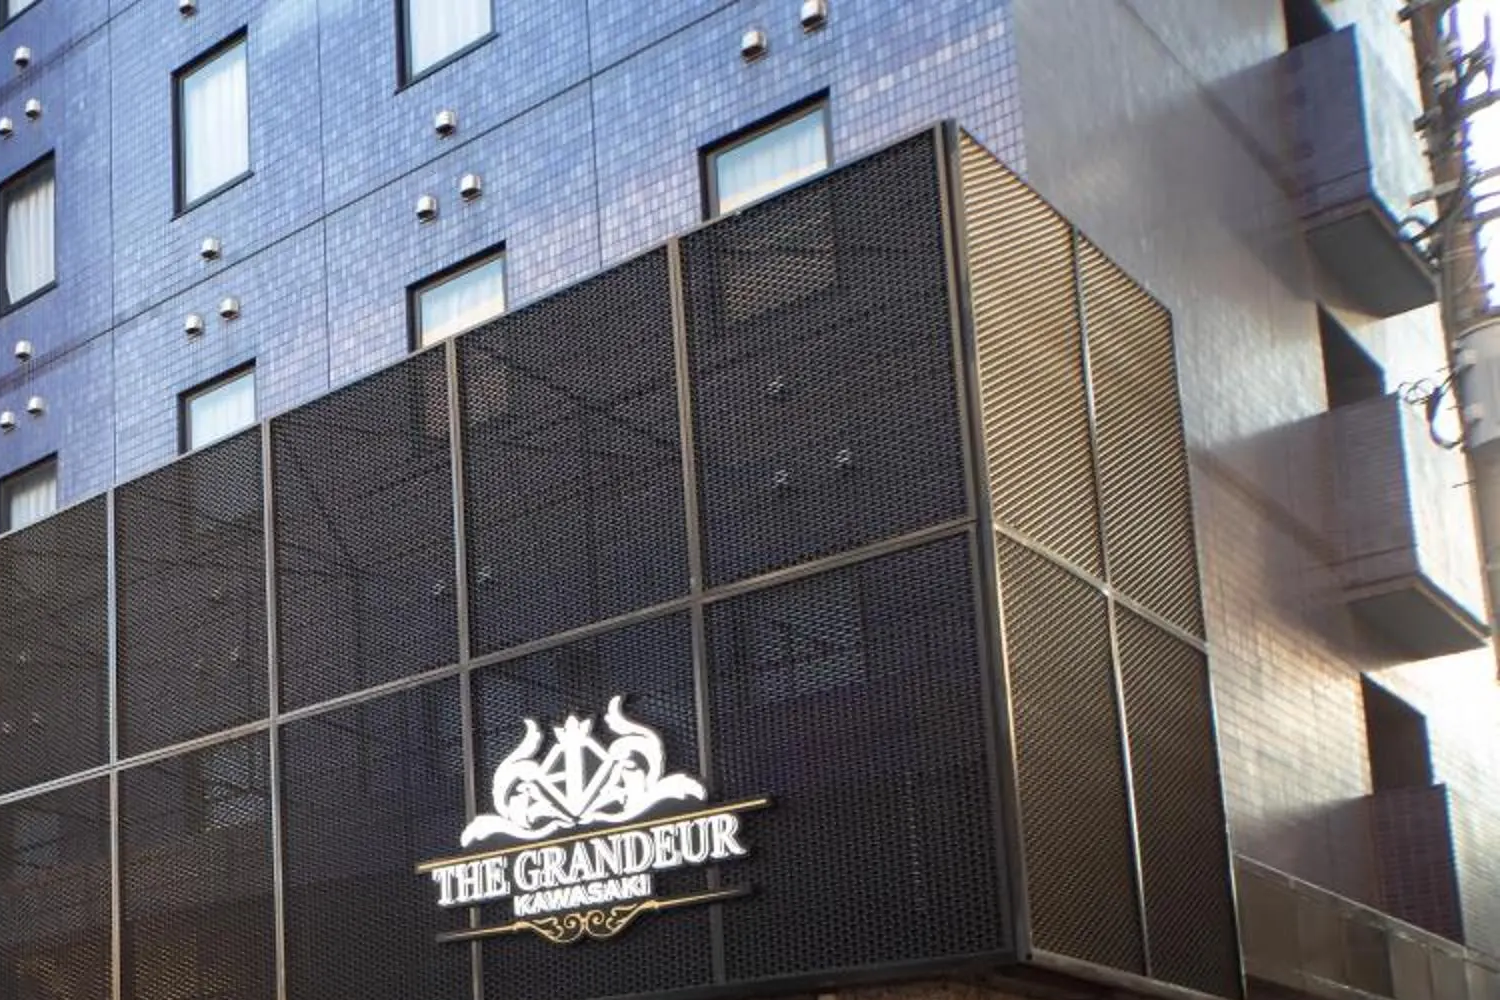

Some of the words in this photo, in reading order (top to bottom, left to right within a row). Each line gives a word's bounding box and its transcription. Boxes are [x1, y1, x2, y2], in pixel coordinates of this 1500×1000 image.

[432, 856, 510, 907] THE
[514, 814, 747, 892] GRANDEUR
[514, 875, 652, 917] KAWASAKI
